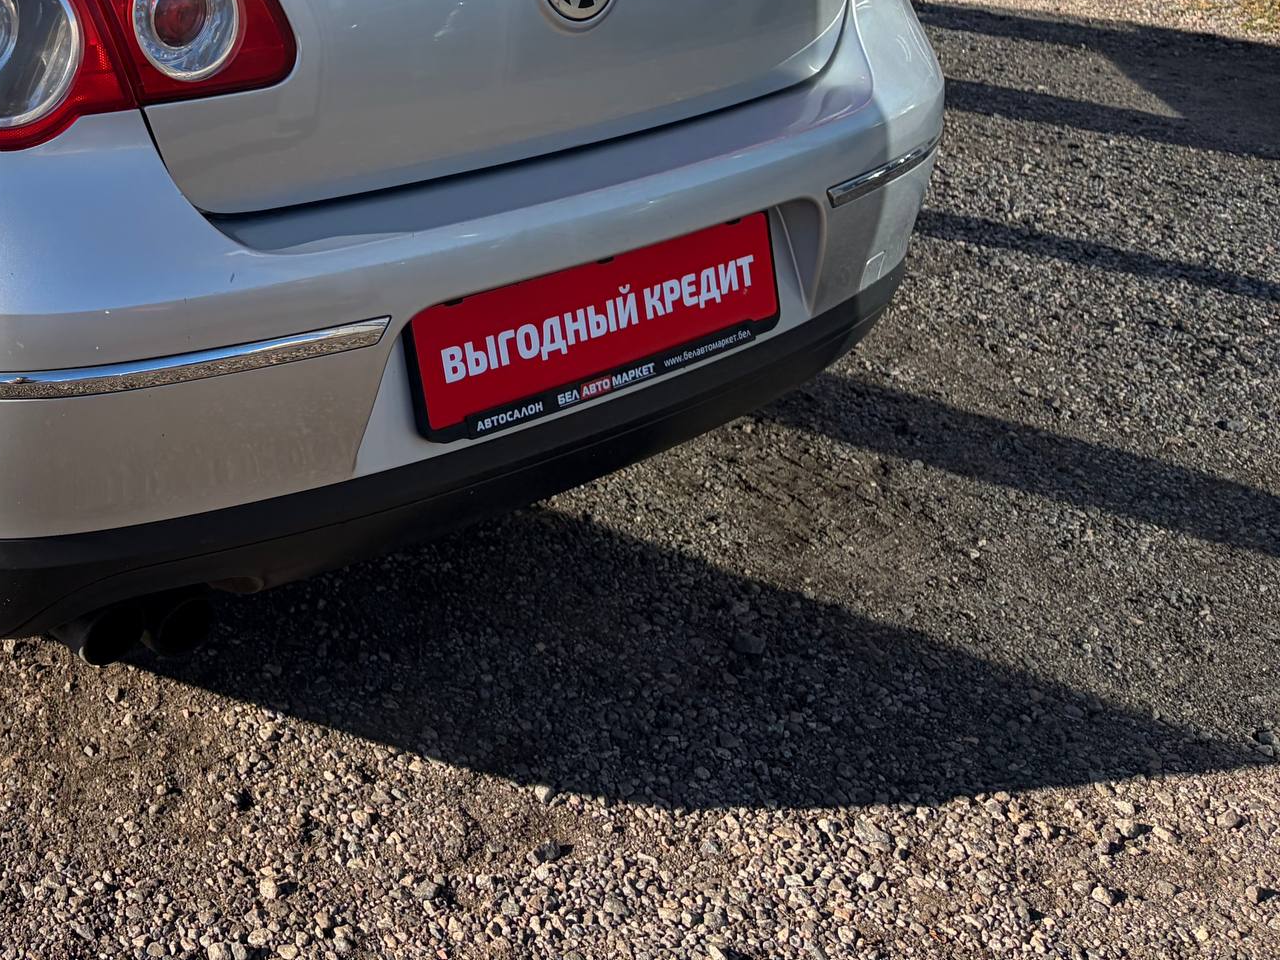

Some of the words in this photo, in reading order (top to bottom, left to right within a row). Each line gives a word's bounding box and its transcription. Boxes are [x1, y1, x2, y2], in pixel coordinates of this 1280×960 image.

[440, 284, 639, 384] ВЫГОДНЫЙ
[643, 254, 754, 320] КРЕДИТ
[476, 400, 544, 433] АВТОСАЛОН
[557, 388, 580, 406] БЕЛ
[581, 378, 611, 399] АВТО
[611, 362, 656, 387] МАРКЕТ
